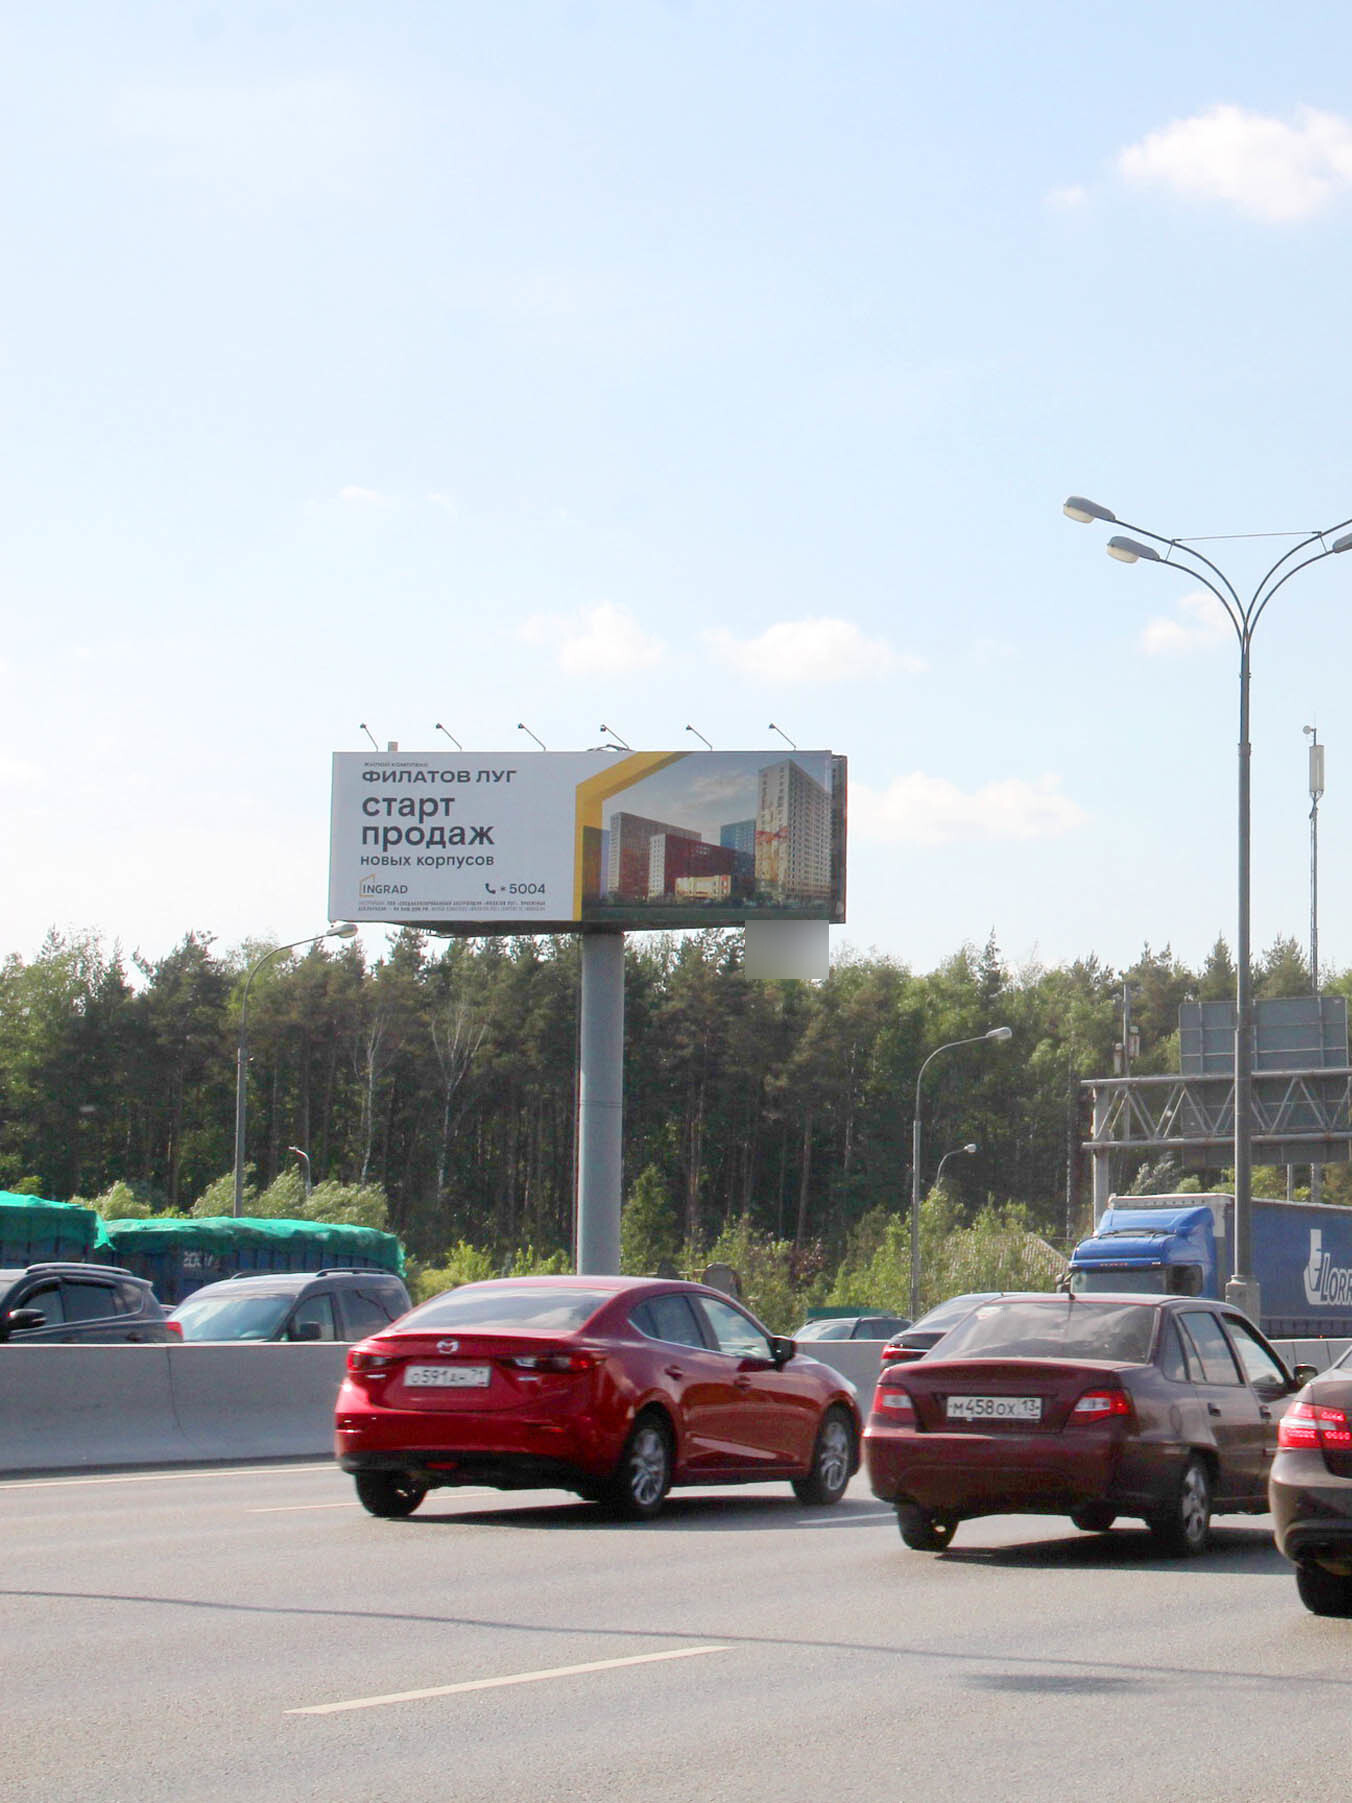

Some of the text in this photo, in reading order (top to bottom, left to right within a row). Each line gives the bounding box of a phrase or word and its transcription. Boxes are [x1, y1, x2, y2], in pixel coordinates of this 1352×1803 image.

[362, 770, 517, 783] ФИЛАТОВ ЛУГ
[362, 797, 455, 824] старт
[362, 826, 495, 852] продаж
[360, 855, 494, 869] новых корпусов
[363, 885, 408, 894] INGRAD
